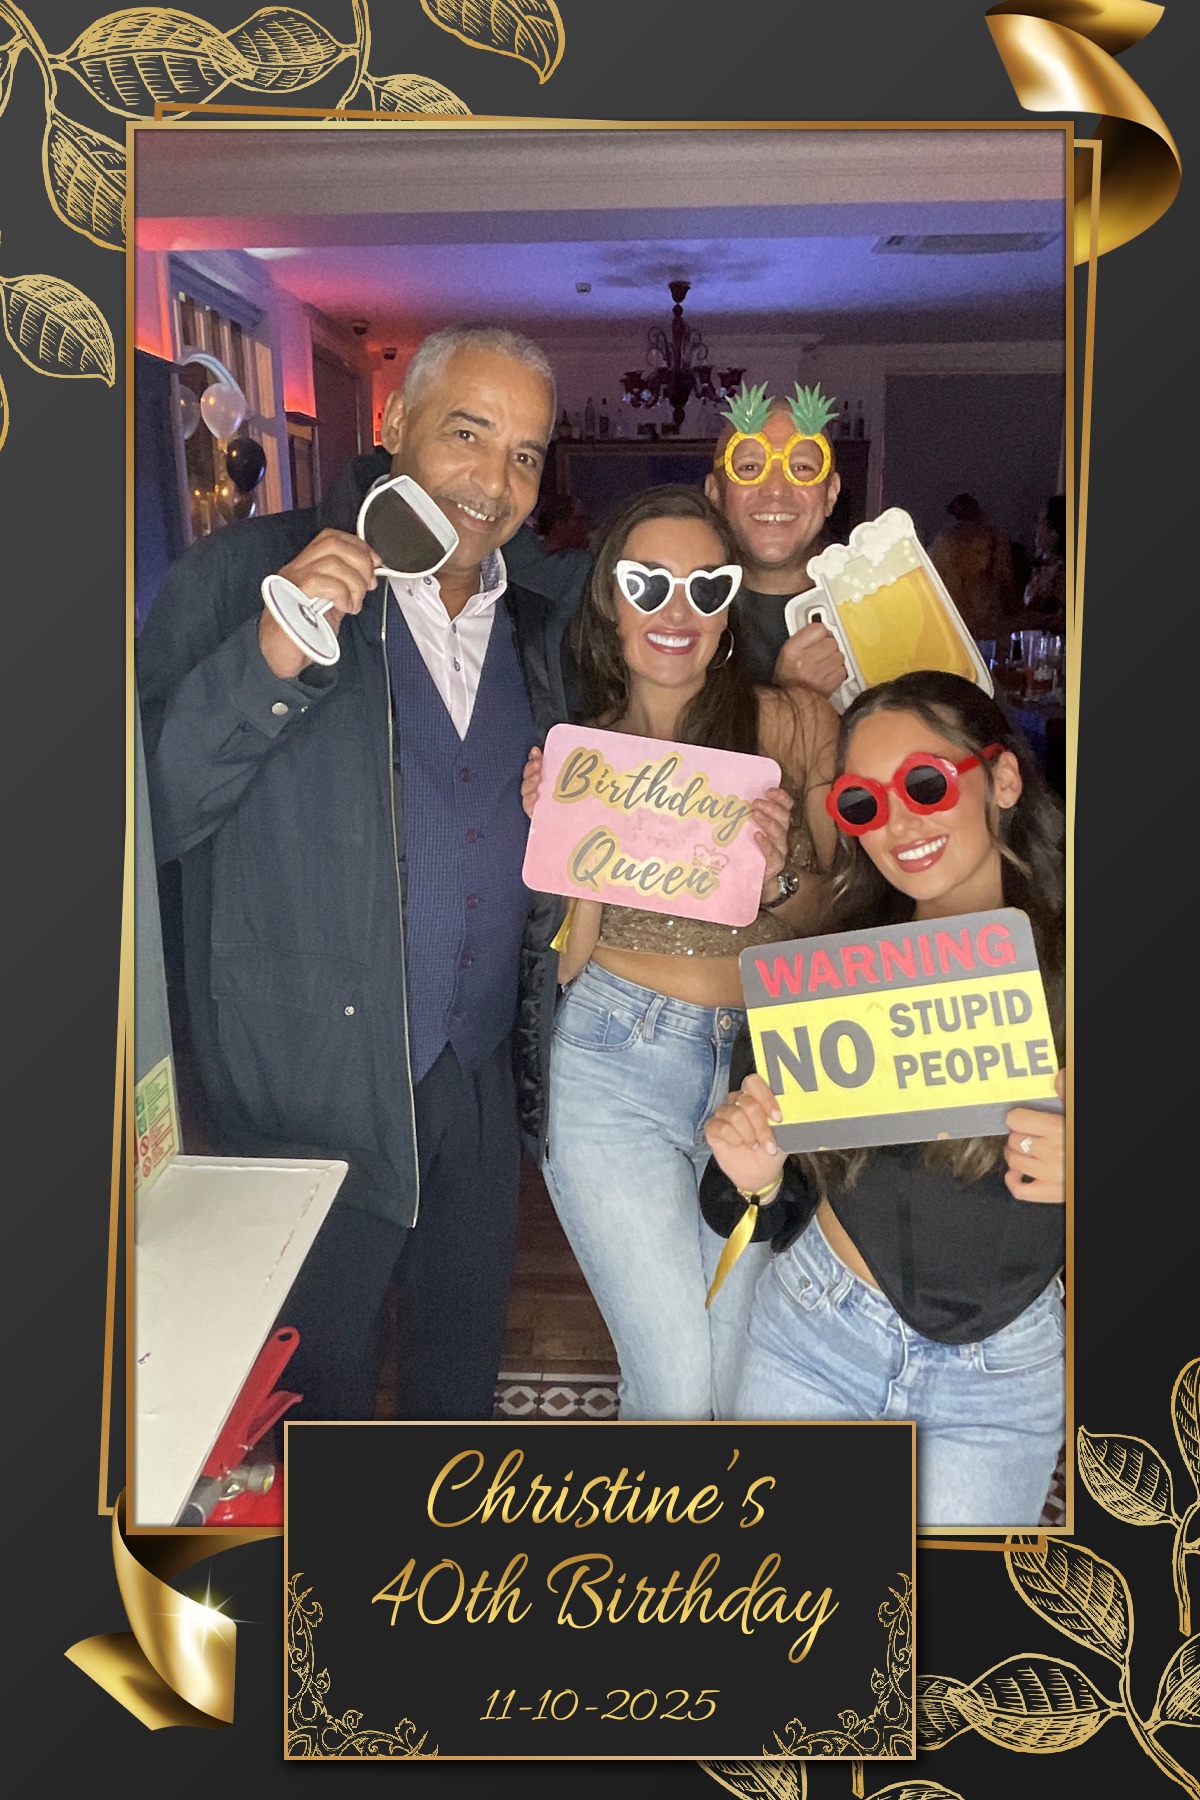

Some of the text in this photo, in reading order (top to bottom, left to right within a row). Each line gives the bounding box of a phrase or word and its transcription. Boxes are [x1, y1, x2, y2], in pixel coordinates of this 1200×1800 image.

[555, 750, 752, 843] Birthday
[570, 829, 717, 896] Queen
[754, 923, 1018, 998] WARNING
[889, 988, 1033, 1038] STUPID
[760, 1019, 876, 1096] NO
[893, 1039, 1054, 1089] PEOPLE
